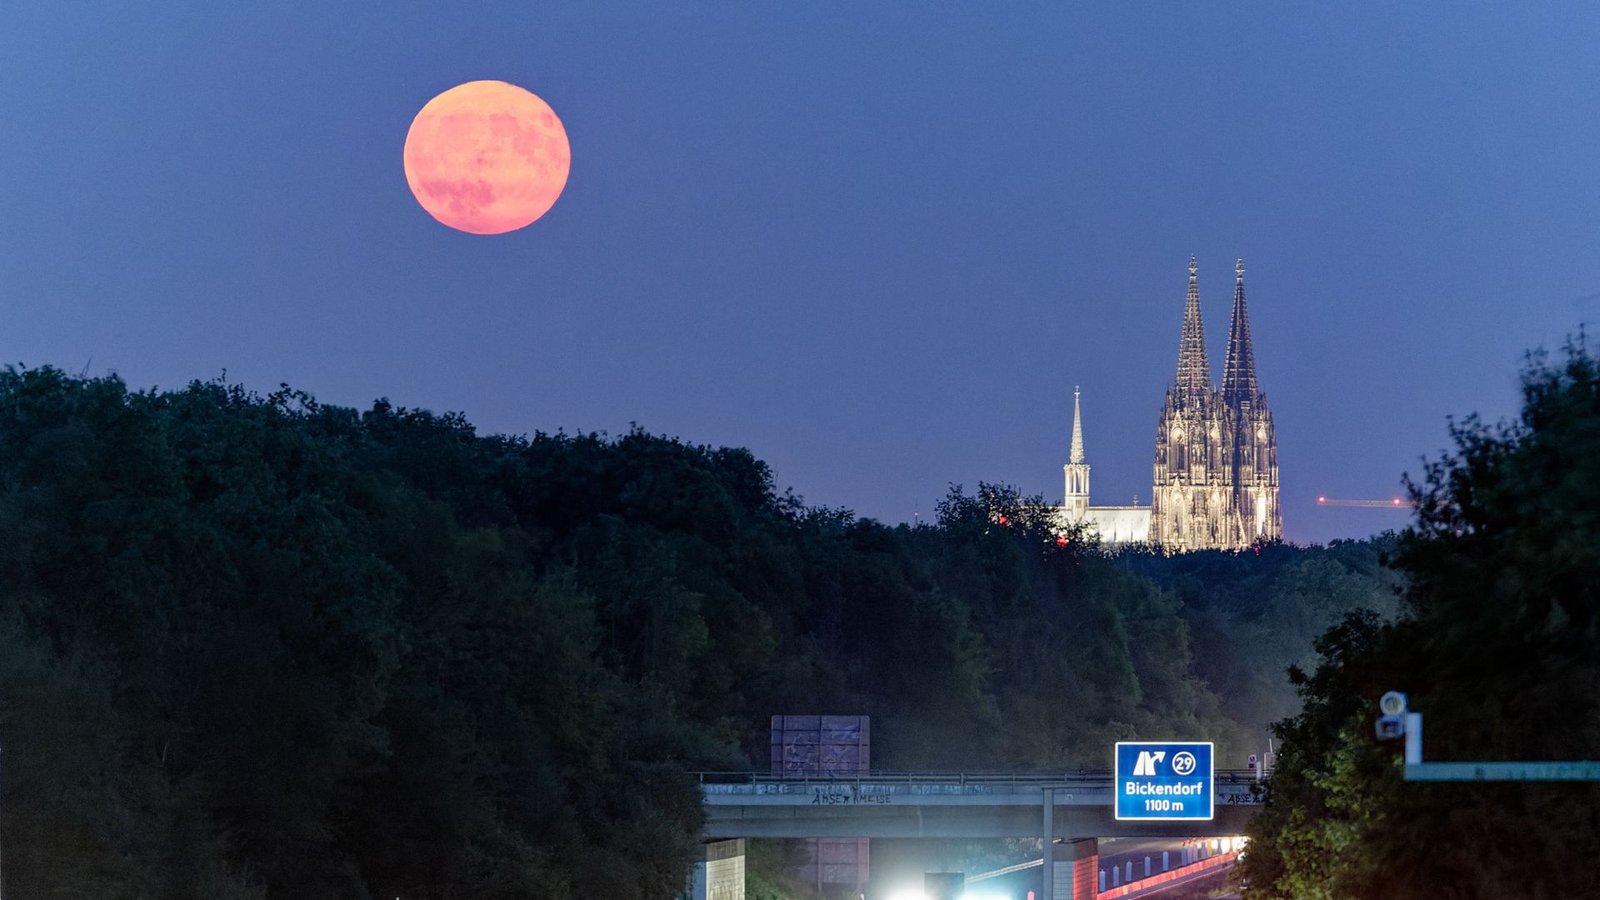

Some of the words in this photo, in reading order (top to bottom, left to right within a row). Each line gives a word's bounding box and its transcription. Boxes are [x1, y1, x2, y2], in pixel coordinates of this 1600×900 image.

[1175, 756, 1192, 770] 29
[1125, 781, 1203, 795] Bickendorf
[1145, 799, 1170, 811] 1100
[1171, 801, 1184, 811] m
